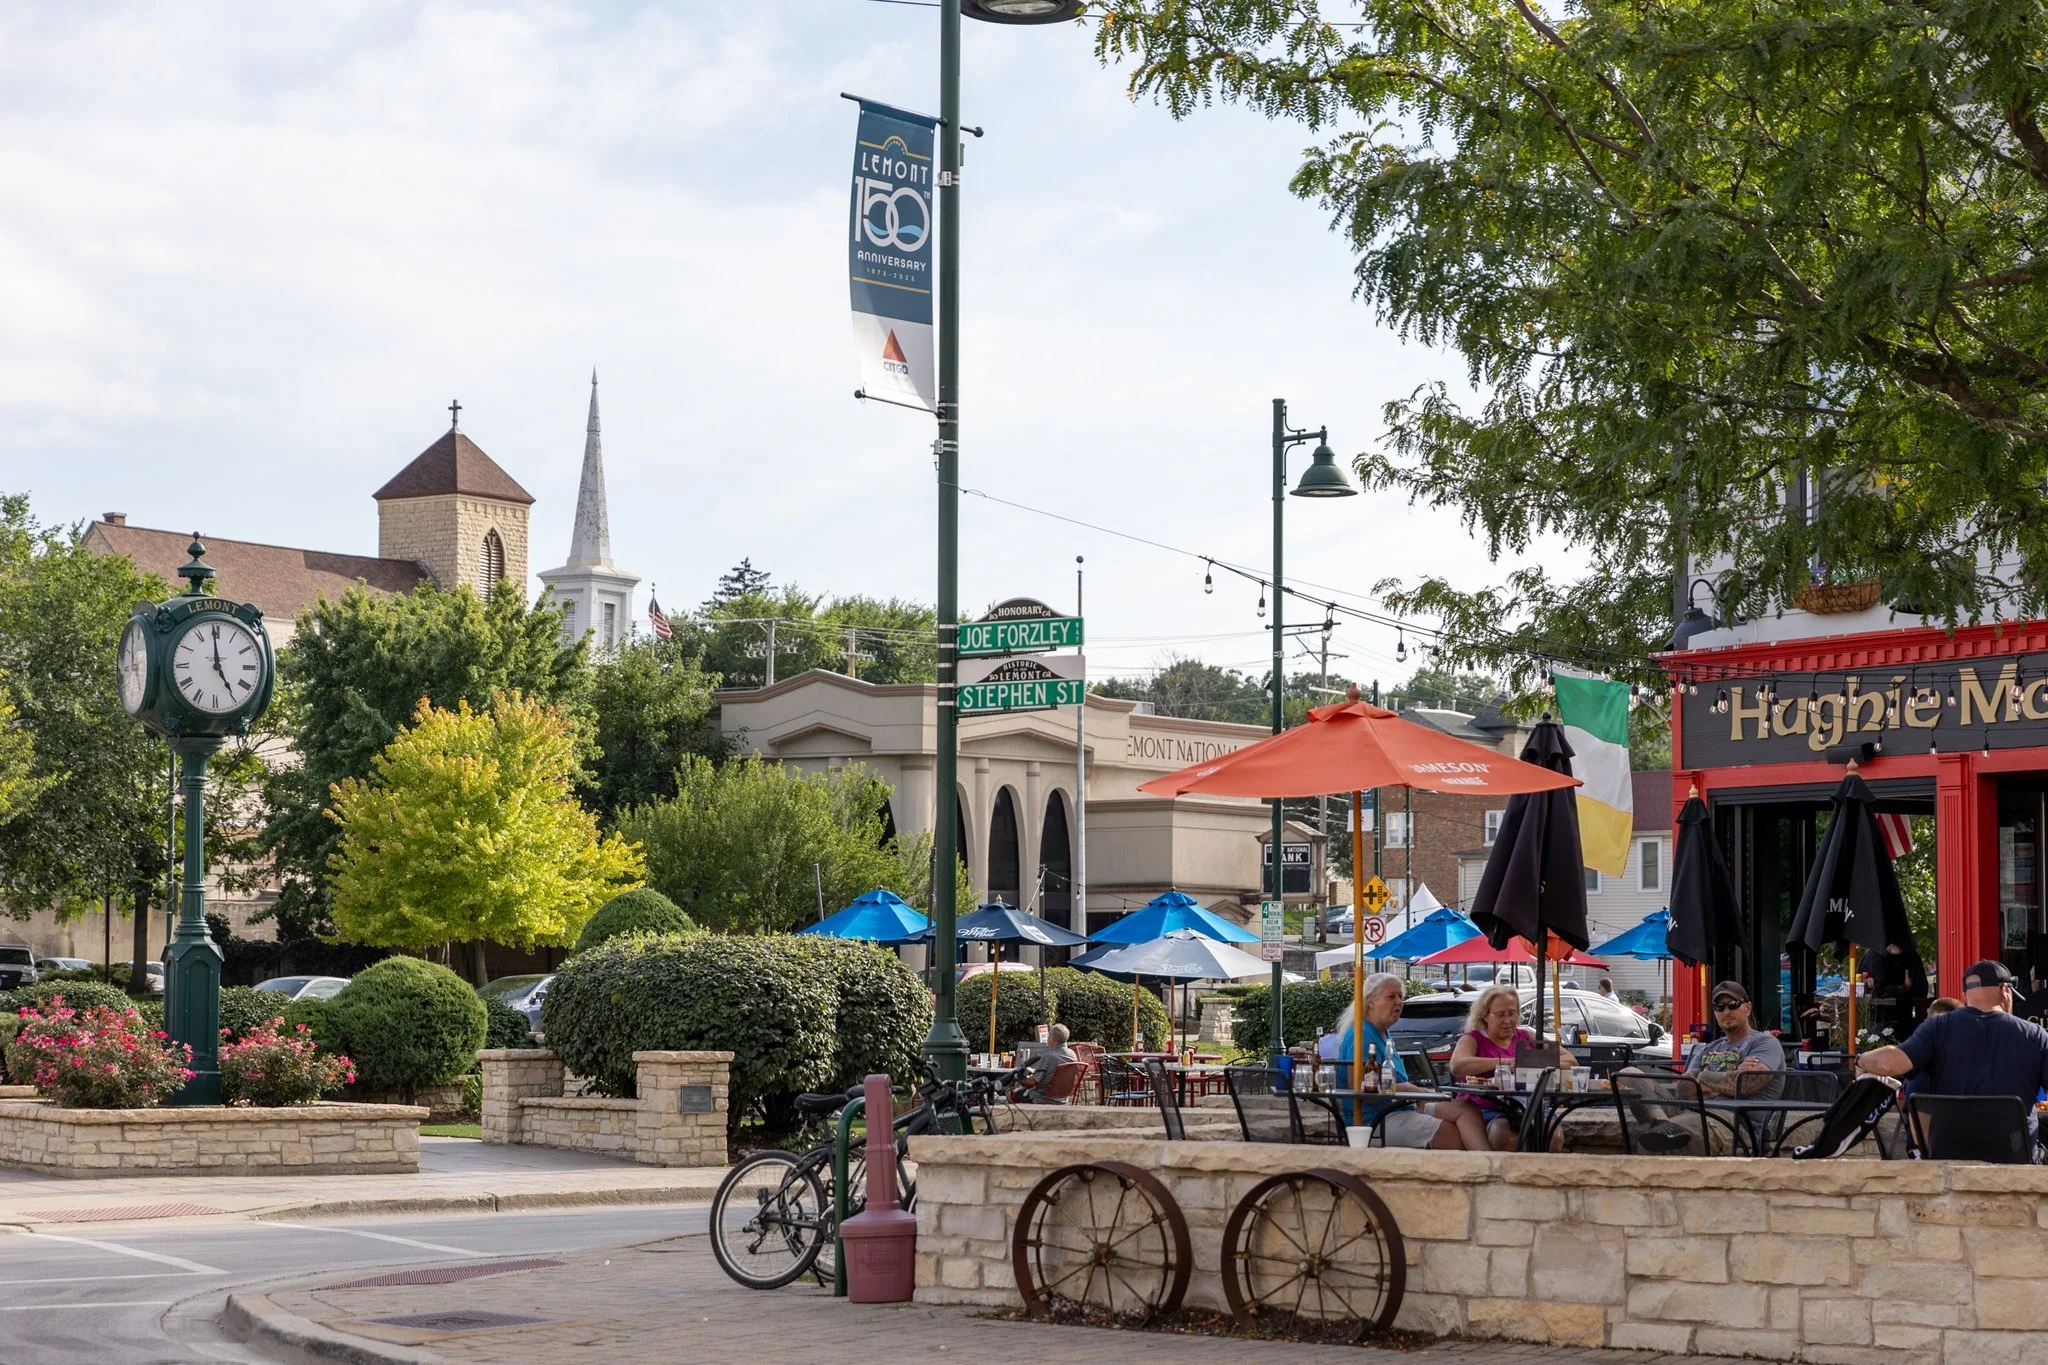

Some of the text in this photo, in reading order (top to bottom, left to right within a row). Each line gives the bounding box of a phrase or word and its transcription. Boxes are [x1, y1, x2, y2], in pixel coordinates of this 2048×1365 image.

[862, 152, 928, 185] LEMONT
[857, 250, 927, 272] ANNIVERSARY
[866, 267, 915, 282] 1873-2023
[883, 361, 909, 375] CITGO
[187, 600, 239, 614] LEMONT
[998, 605, 1043, 617] HONORARY
[961, 626, 993, 650] JOE
[997, 621, 1071, 648] FORZLEY
[1003, 661, 1038, 671] HISTORIC
[1000, 670, 1042, 681] LEMONT
[962, 681, 1080, 709] STEPHEN ST
[1730, 674, 1942, 752] Hughie
[1176, 739, 1238, 763] NATION
[1281, 852, 1303, 862] ANK
[1263, 905, 1268, 917] 4
